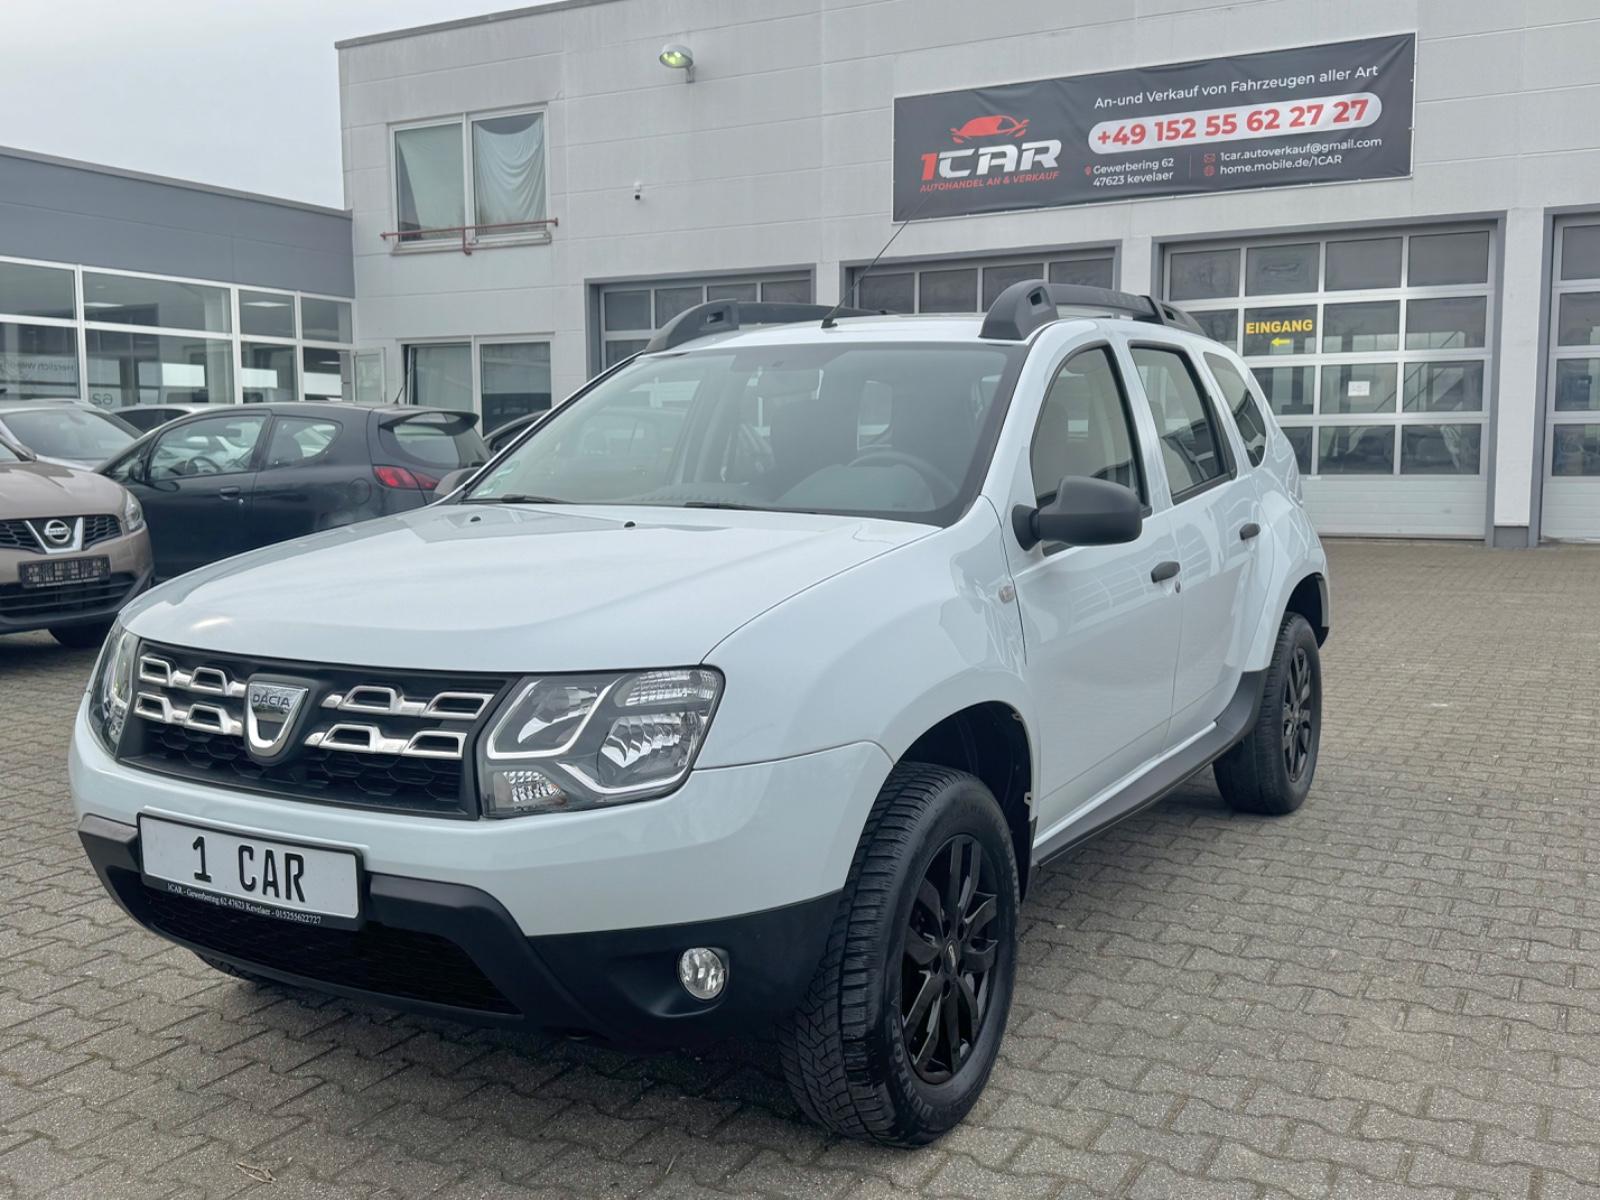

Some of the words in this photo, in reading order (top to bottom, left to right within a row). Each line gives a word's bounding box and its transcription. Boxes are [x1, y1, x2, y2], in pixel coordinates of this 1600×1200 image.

[1094, 92, 1143, 109] An-und
[1147, 86, 1199, 103] Verkauf
[1202, 84, 1227, 97] von
[1231, 74, 1315, 92] Fahrzeugen
[1319, 69, 1352, 83] aller
[1355, 65, 1379, 78] Art
[1098, 121, 1146, 146] +49
[1154, 117, 1198, 142] 152
[1205, 114, 1237, 137] 55
[1246, 108, 1280, 131] 62
[1289, 104, 1324, 128] 27
[1333, 98, 1369, 123] 27
[920, 139, 1062, 181] 1CAR
[1220, 138, 1383, 161] 1car.autoverkauf@gmail.com
[1093, 159, 1160, 175] Gewerbering
[1162, 157, 1175, 168] 62
[1220, 154, 1343, 175] home.mobile.de/1CAR
[919, 178, 984, 193] AUTOHANDEL
[986, 177, 1002, 187] AN
[1003, 176, 1010, 185] &
[1013, 171, 1061, 184] VERKAUF
[1093, 175, 1125, 187] 47623
[1127, 171, 1174, 183] kevelaer
[1246, 319, 1313, 334] EINGANG
[252, 693, 290, 707] DACIA
[192, 835, 212, 883] 1
[238, 845, 306, 903] CAR
